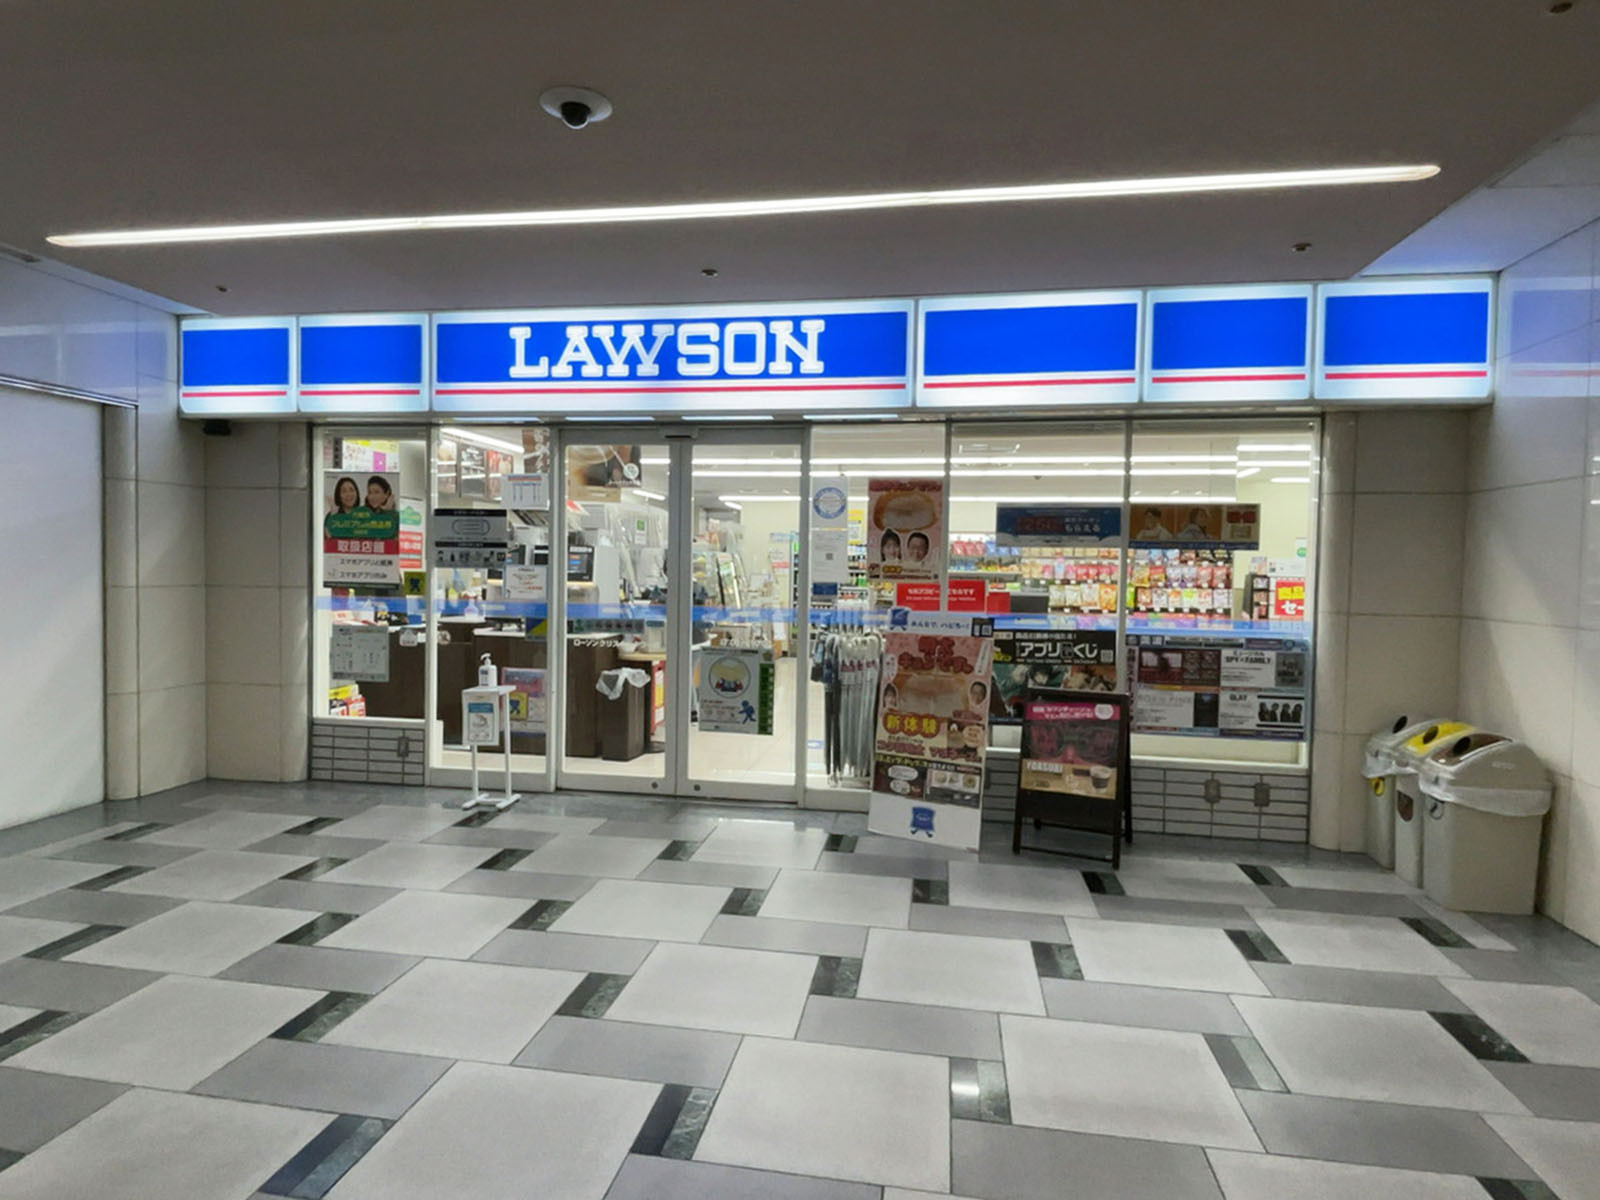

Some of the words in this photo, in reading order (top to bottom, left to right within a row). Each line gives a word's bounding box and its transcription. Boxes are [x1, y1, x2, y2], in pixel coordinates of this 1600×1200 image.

[509, 318, 825, 379] LAWSON
[337, 539, 386, 553] 取扱店舗
[1229, 693, 1248, 702] GLAY
